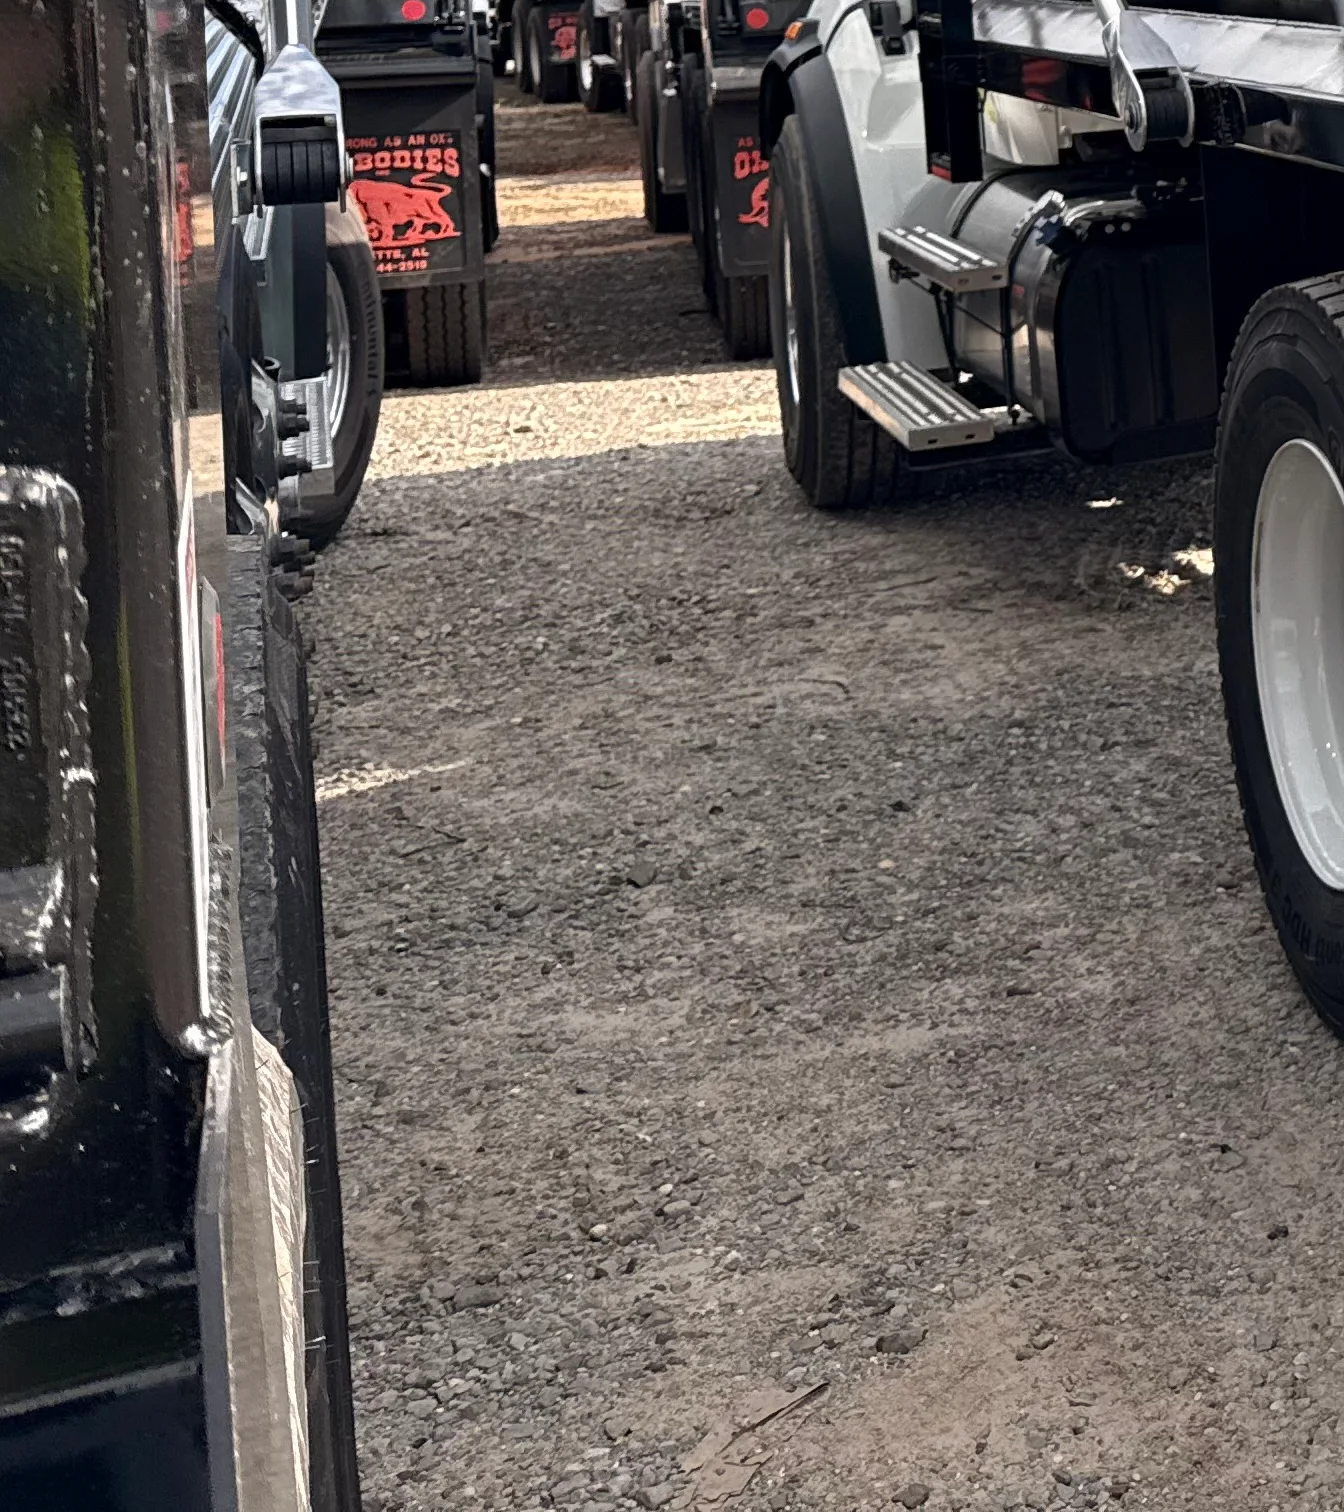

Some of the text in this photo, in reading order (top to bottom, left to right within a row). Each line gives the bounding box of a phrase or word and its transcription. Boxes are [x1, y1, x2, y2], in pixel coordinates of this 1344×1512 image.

[346, 137, 378, 149] RONG
[353, 148, 460, 178] BODIES
[375, 260, 428, 273] 44-2519
